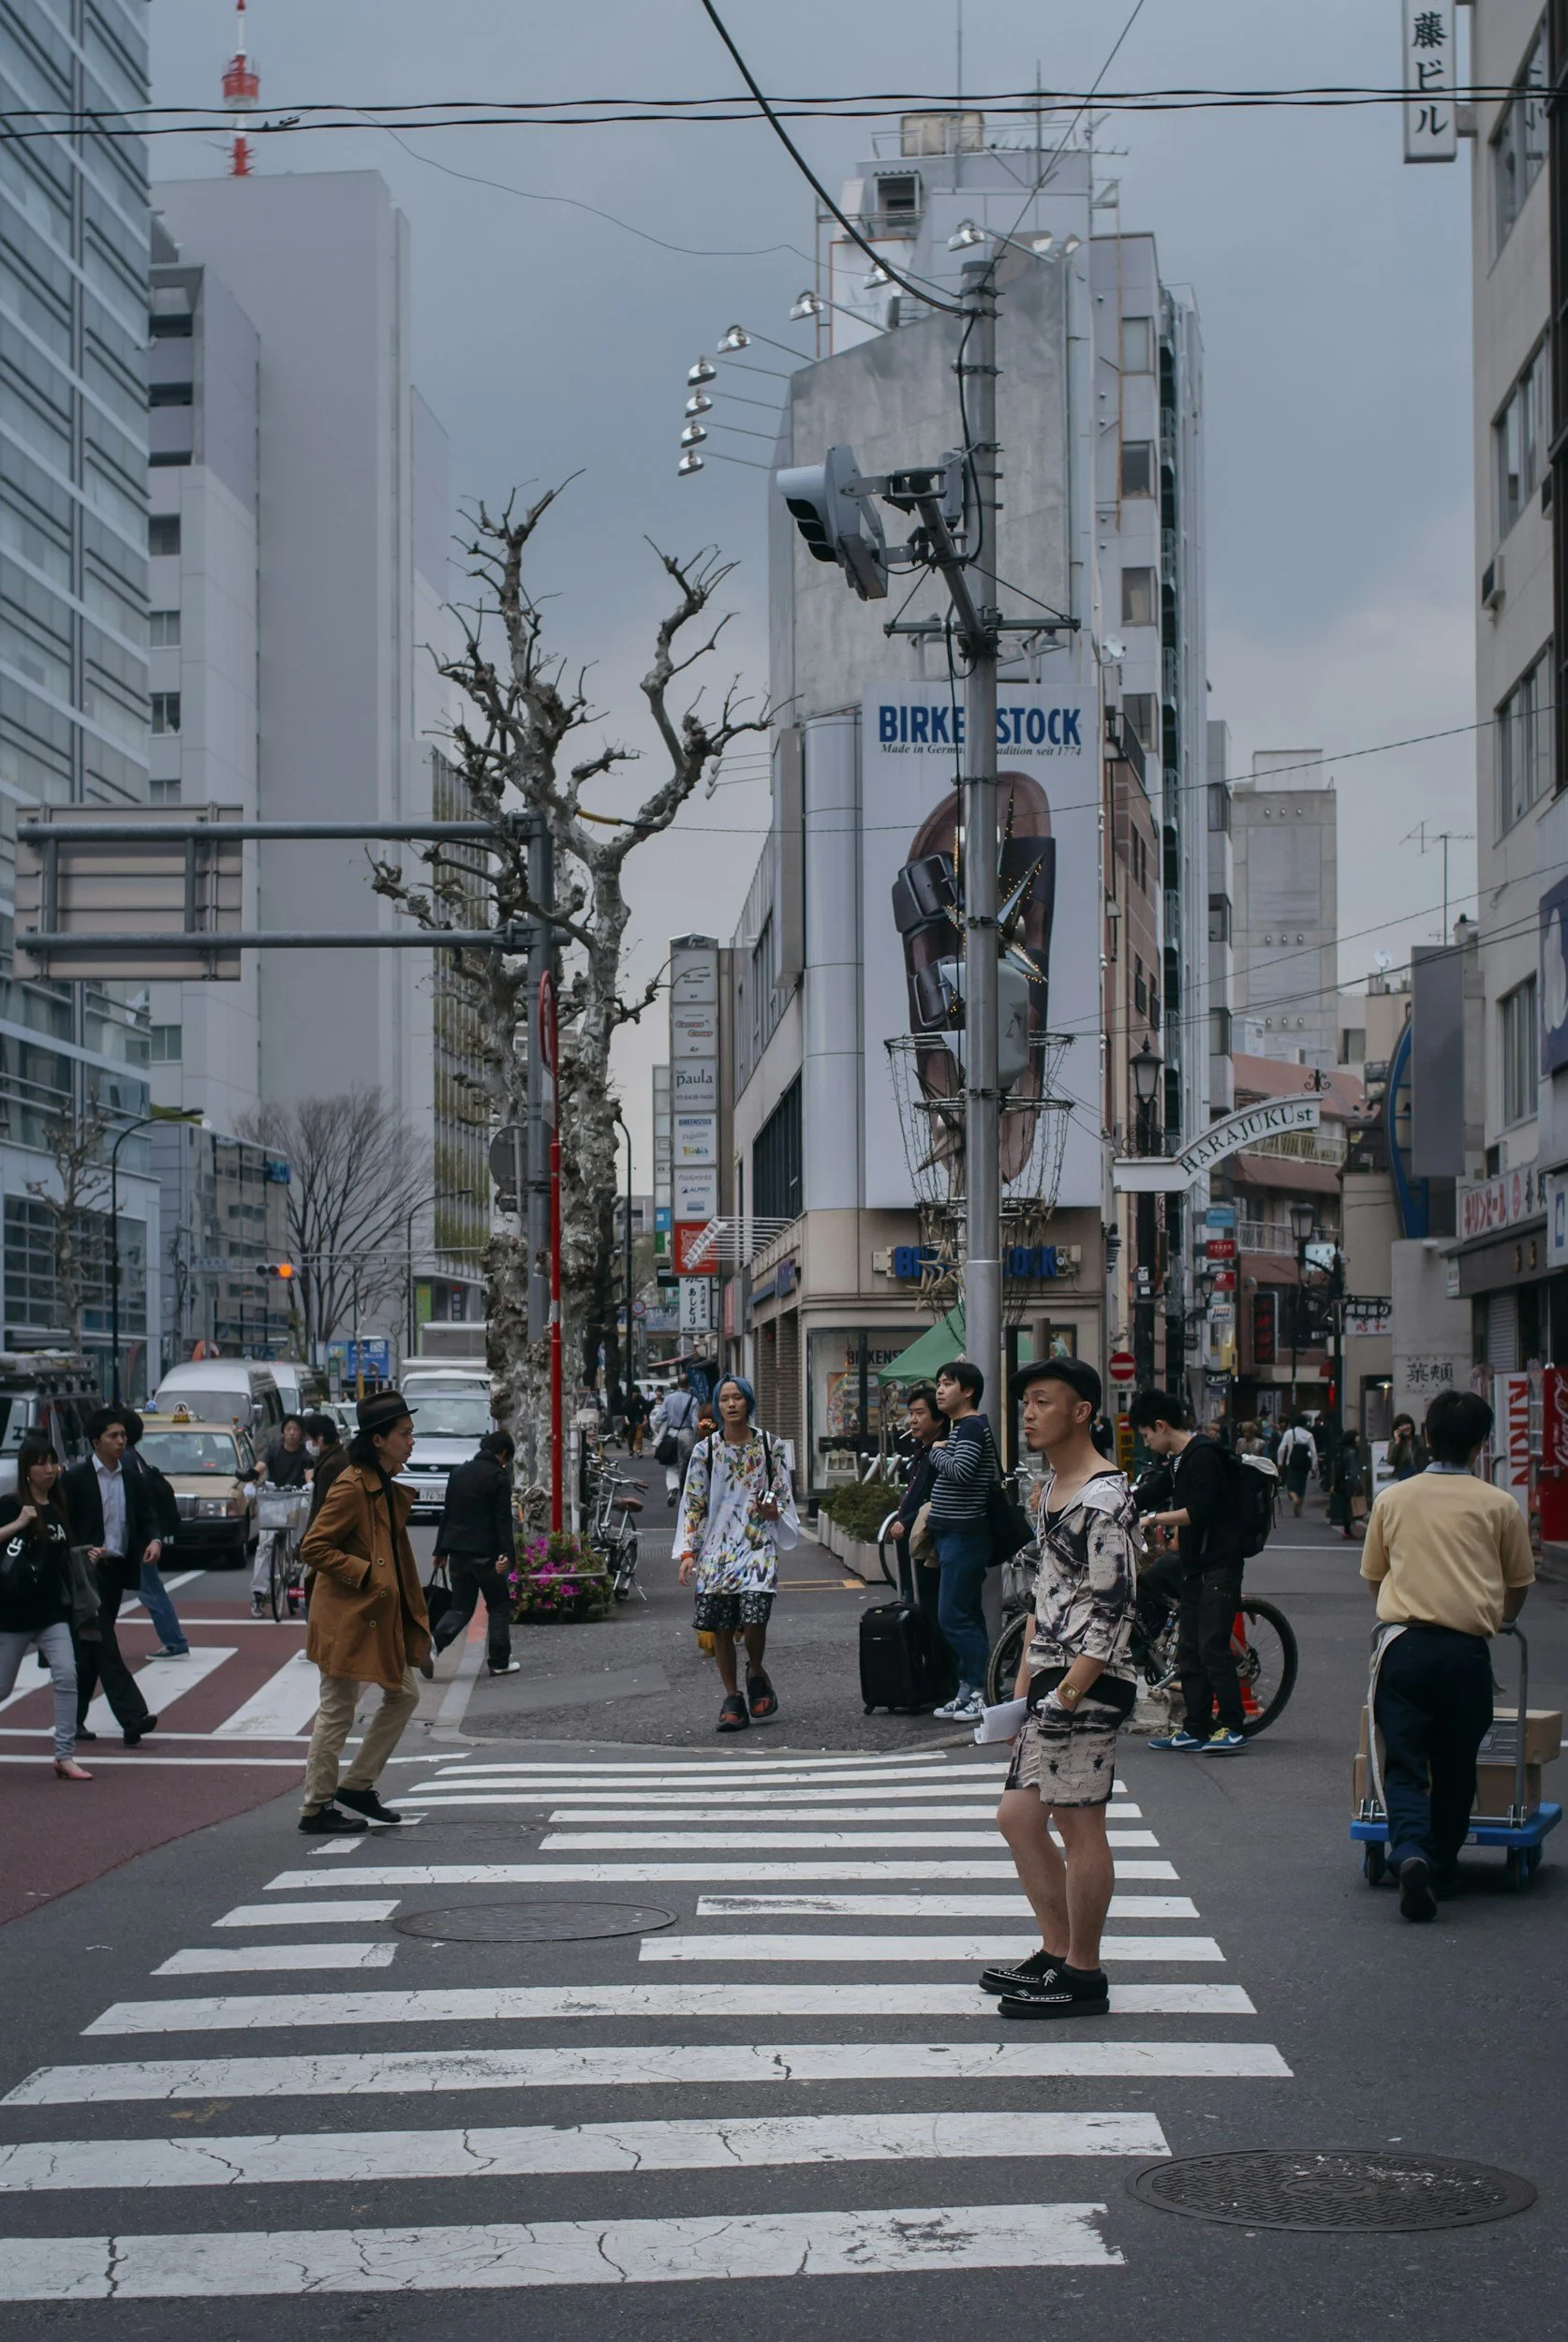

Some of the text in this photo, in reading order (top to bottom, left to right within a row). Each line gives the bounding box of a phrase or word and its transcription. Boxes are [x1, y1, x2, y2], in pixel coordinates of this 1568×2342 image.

[1412, 0, 1449, 137] 藤ビル
[879, 705, 1081, 746] BIRKESTOCK
[881, 744, 910, 754] Made
[913, 744, 925, 754] in
[1036, 746, 1055, 756] seit
[1058, 747, 1082, 757] 1774
[676, 1069, 714, 1089] paula
